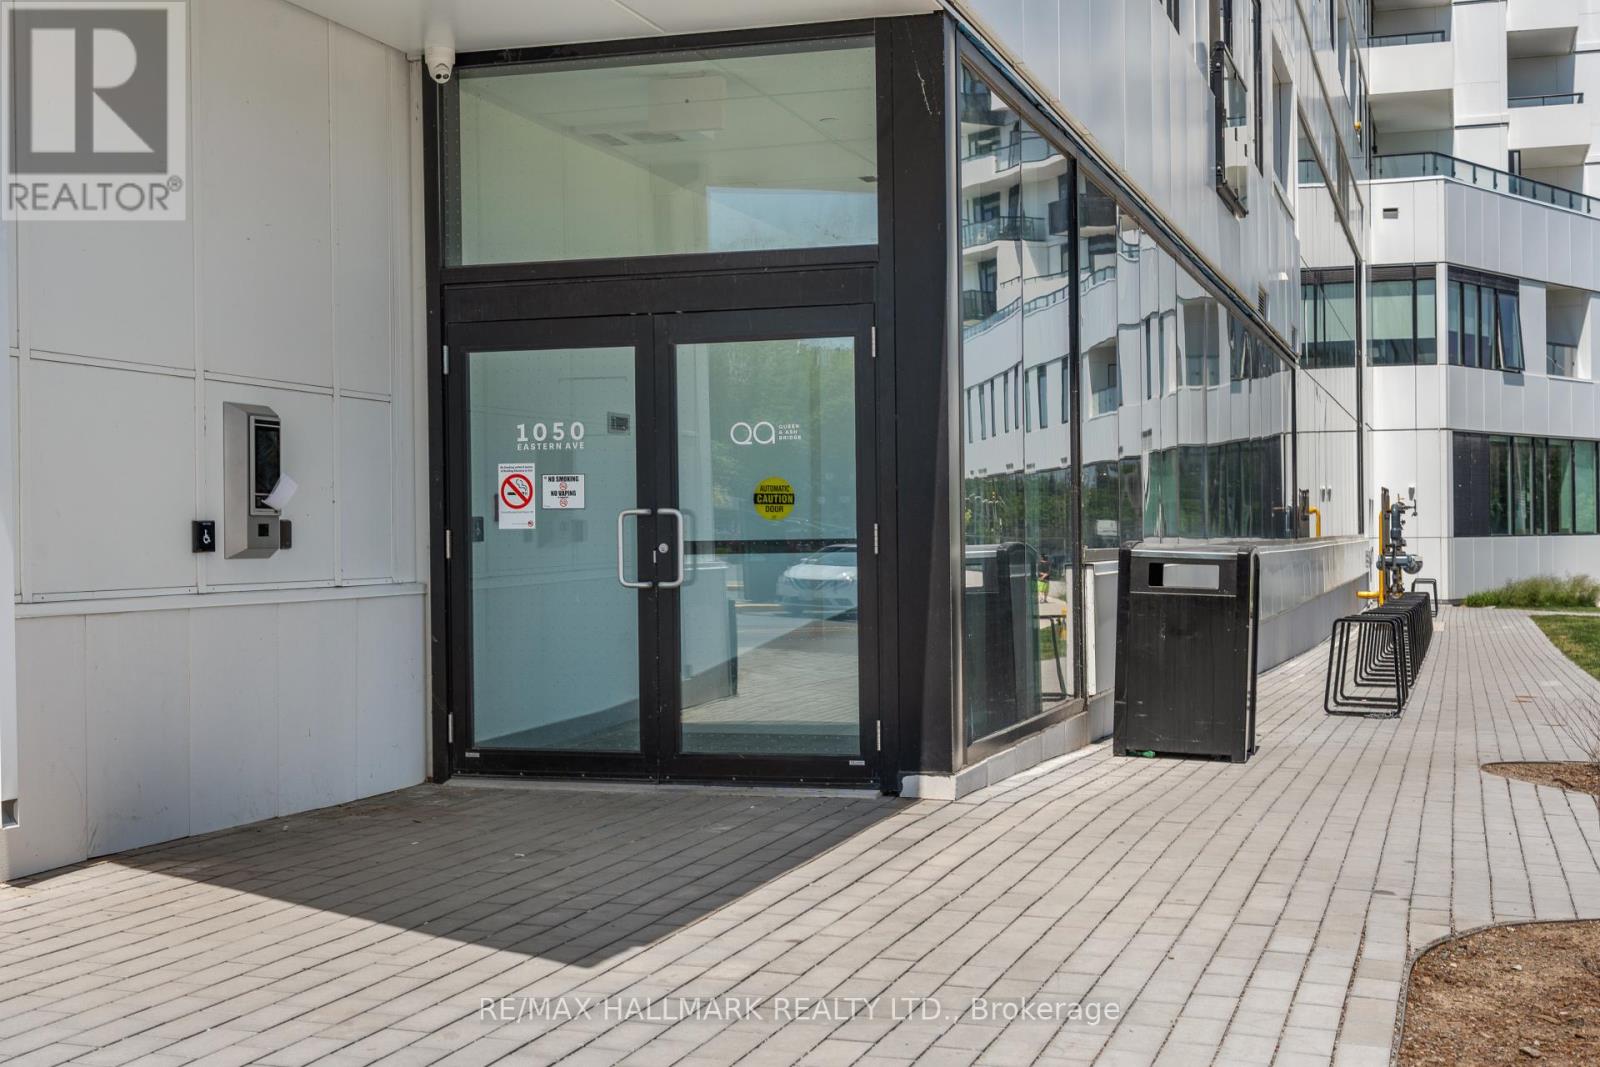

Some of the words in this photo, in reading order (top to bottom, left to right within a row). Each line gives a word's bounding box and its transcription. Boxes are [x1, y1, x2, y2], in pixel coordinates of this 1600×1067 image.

[516, 421, 585, 442] 1050
[517, 442, 562, 451] EASTERN
[565, 441, 585, 450] AVE
[558, 489, 577, 497] VAPING
[756, 494, 794, 504] CAUTION
[765, 505, 784, 513] DOOR
